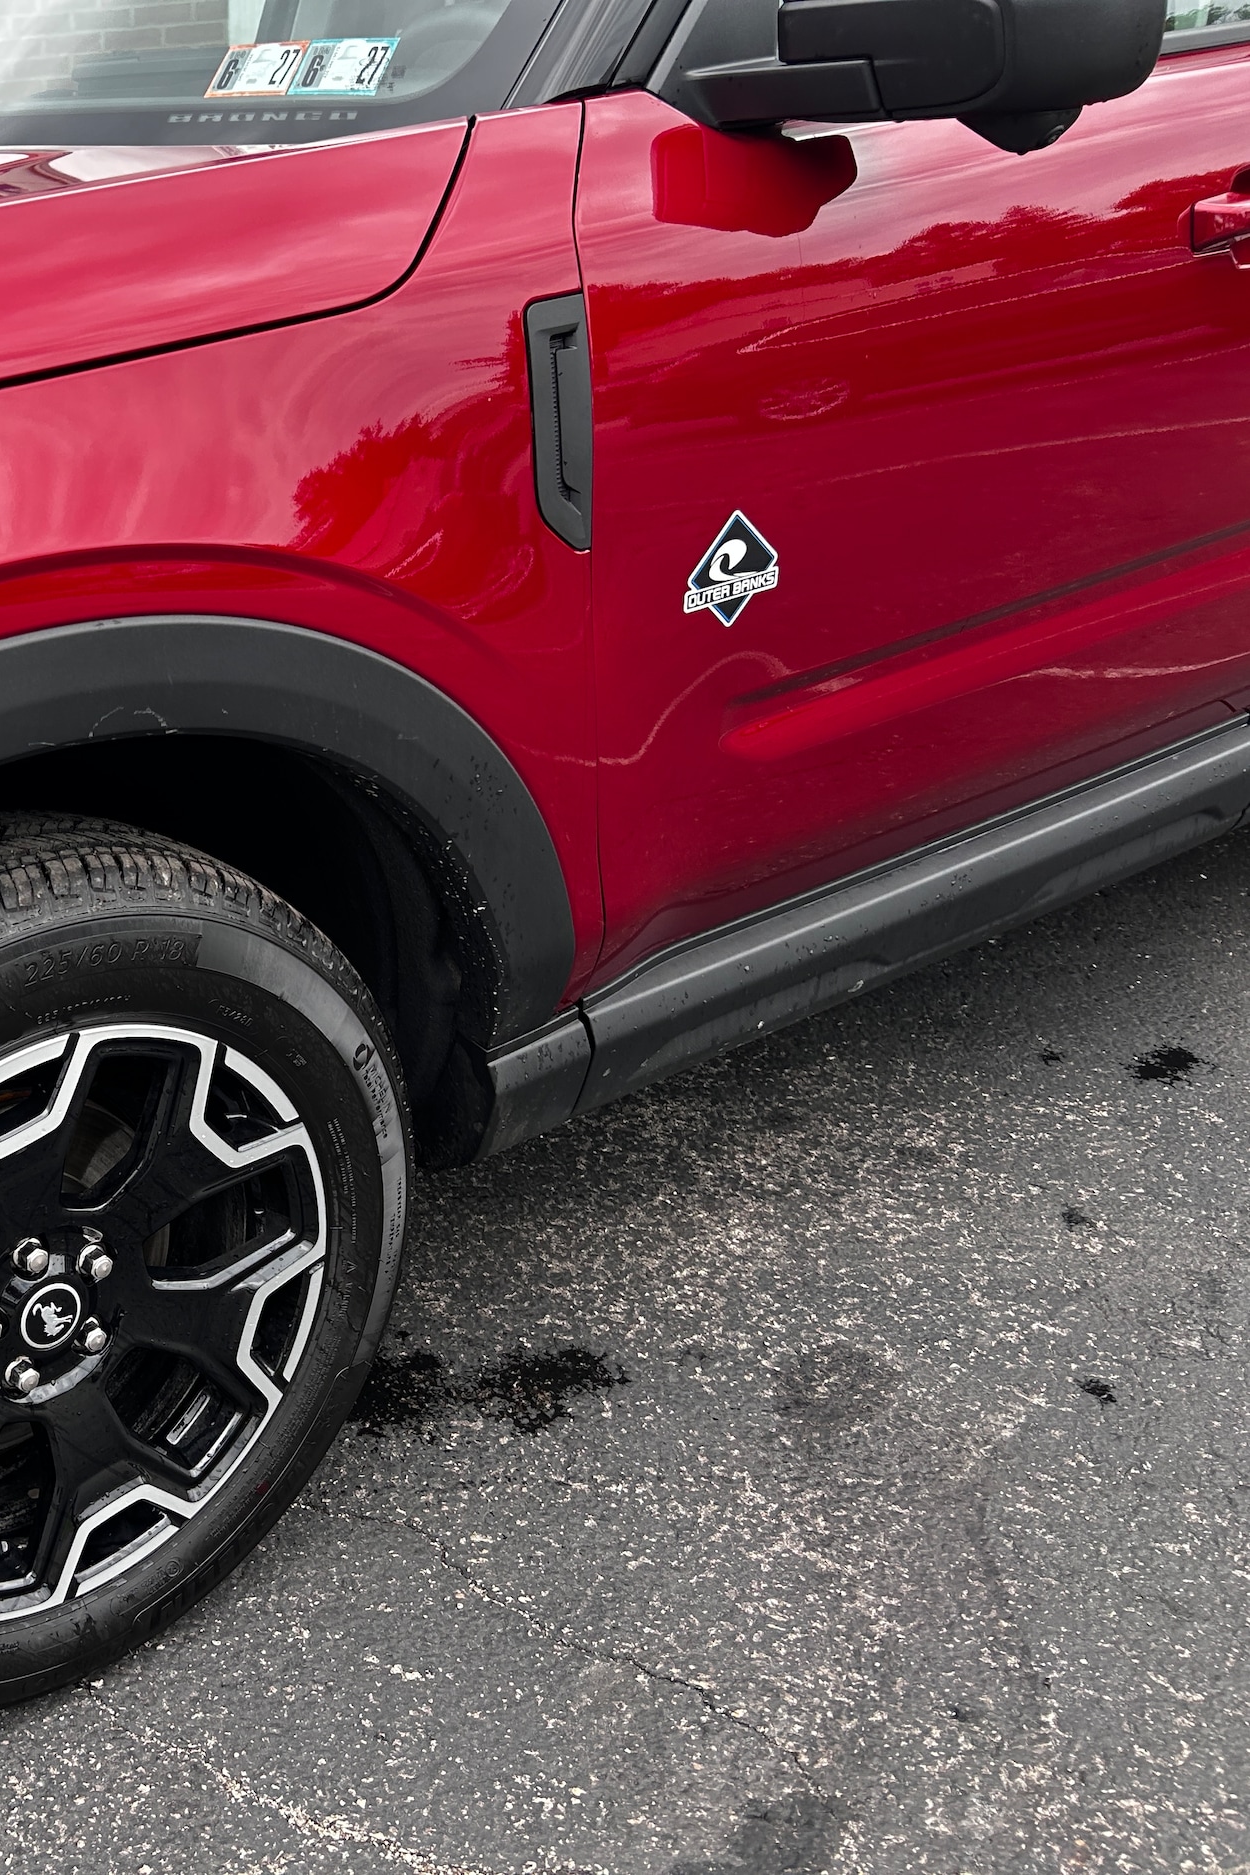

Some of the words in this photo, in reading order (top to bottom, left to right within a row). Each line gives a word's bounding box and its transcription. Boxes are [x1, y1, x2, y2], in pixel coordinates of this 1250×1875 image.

[268, 48, 301, 86] 27
[355, 45, 391, 85] 27
[167, 110, 359, 123] BRONCO
[687, 585, 731, 608] OUTER
[732, 571, 777, 596] BANKS
[23, 938, 124, 988] 225/60
[130, 938, 150, 962] R
[159, 938, 186, 962] 18
[367, 1064, 393, 1116] MICHELIN
